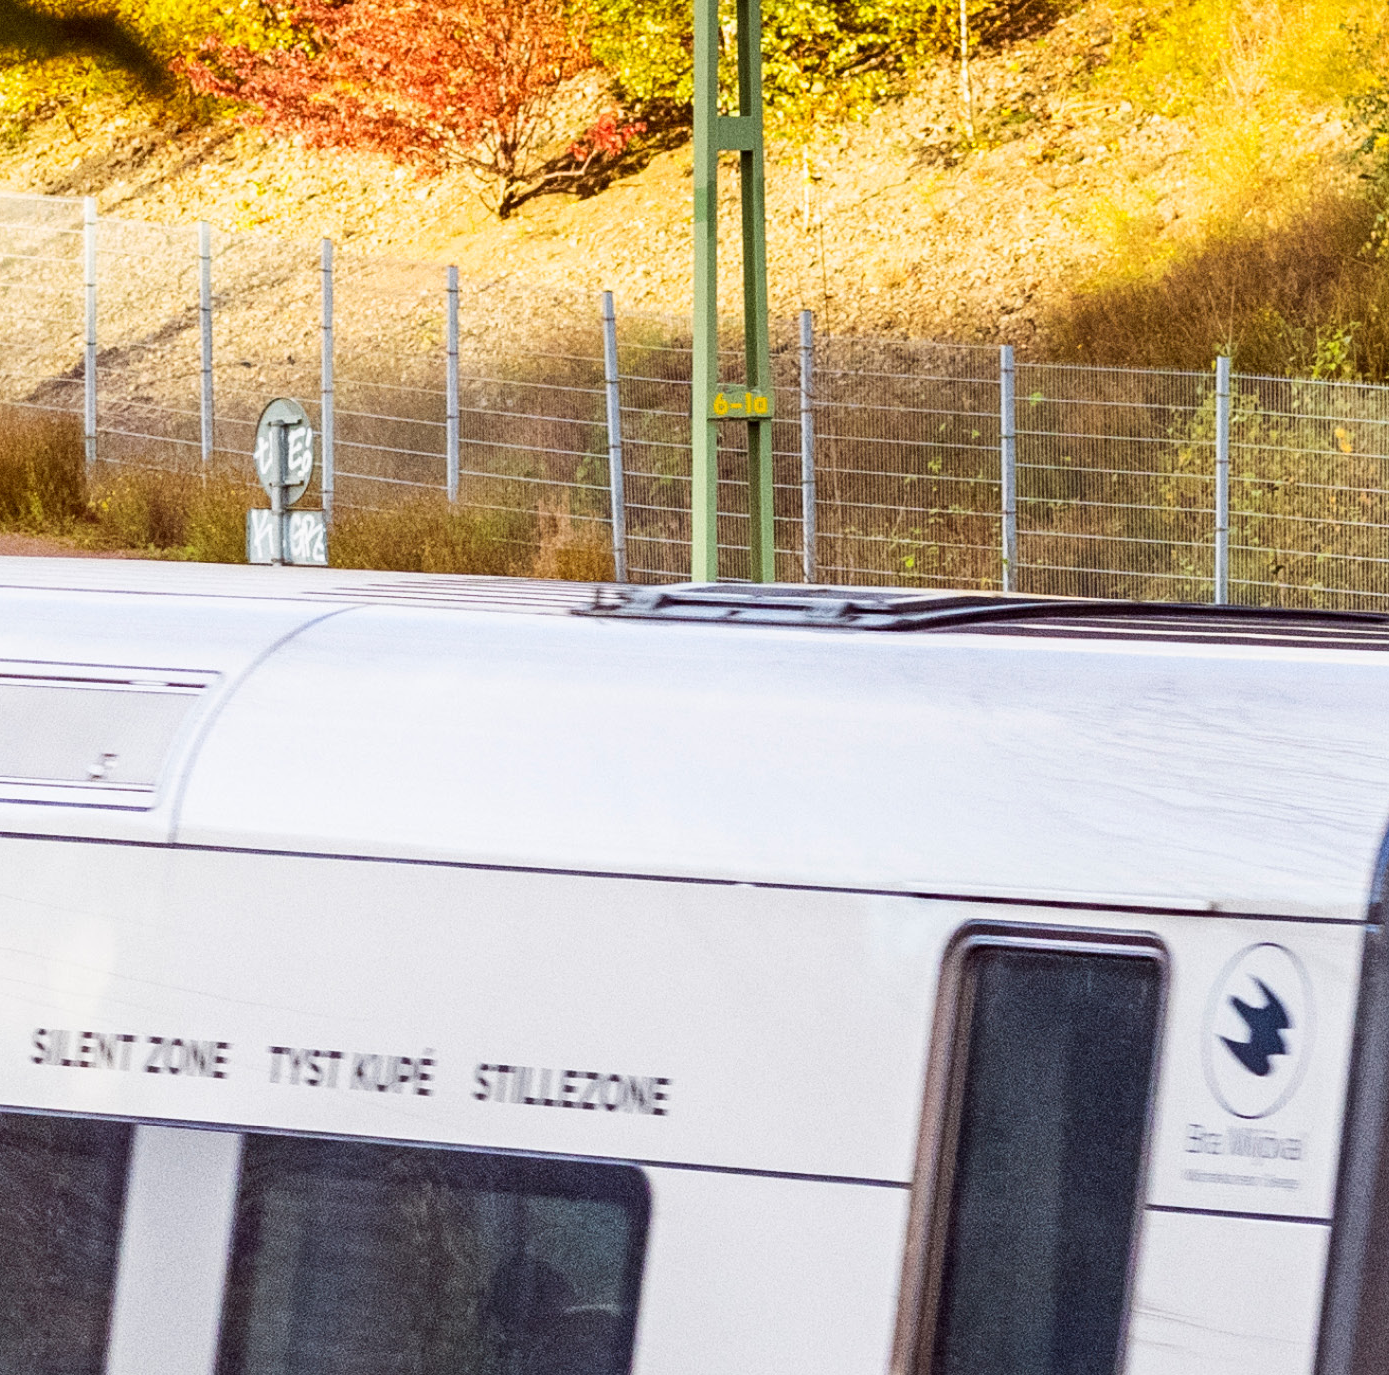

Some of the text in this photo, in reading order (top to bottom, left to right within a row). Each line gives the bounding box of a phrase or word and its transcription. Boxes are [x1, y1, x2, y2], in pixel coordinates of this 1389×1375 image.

[30, 1028, 138, 1070] SILENT
[144, 1036, 232, 1079] ZONE
[269, 1046, 343, 1088] TYST
[349, 1047, 437, 1097] KUPÉ
[472, 1063, 672, 1117] STILLEZONE
